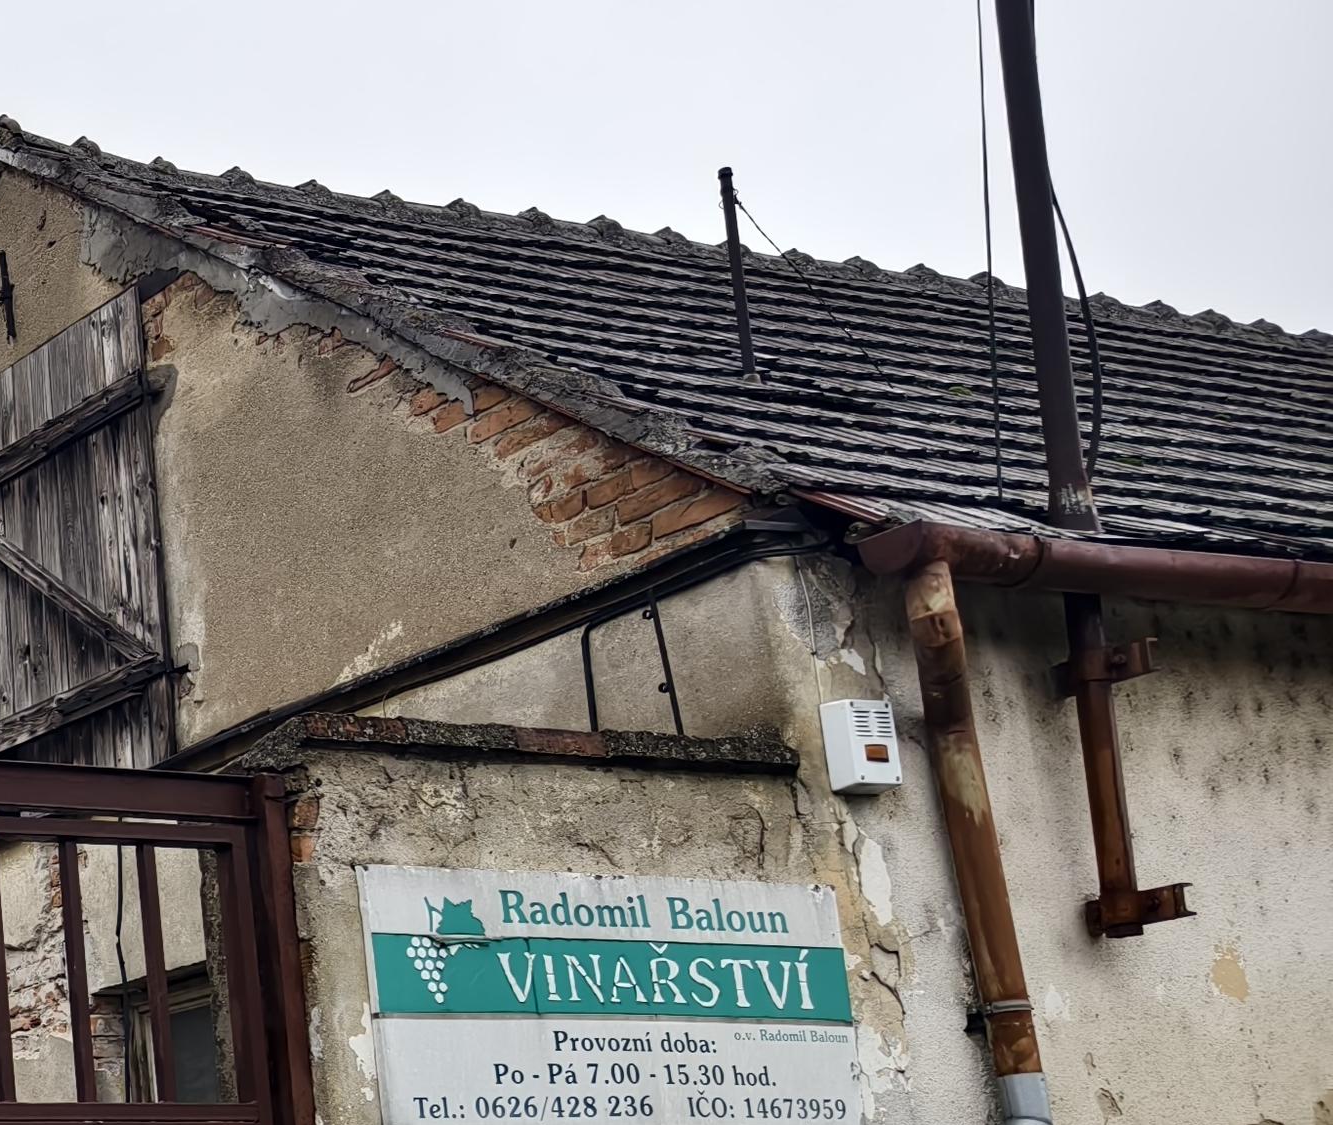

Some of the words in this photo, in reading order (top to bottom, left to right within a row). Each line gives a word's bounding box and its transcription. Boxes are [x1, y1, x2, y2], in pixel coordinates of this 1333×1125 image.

[499, 889, 651, 929] Radomil
[666, 896, 789, 934] Baloun
[496, 942, 815, 1010] VINAŘSTVÍ
[552, 1030, 653, 1053] Provozní
[660, 1032, 717, 1054] doba:
[759, 1029, 807, 1043] Radomil
[810, 1030, 849, 1044] Baloun
[493, 1063, 525, 1085] Po
[547, 1063, 578, 1085] Pá
[586, 1063, 640, 1085] 7.00
[663, 1064, 725, 1086] 15.30
[732, 1065, 777, 1087] hod.
[413, 1097, 465, 1119] Tel.:
[475, 1096, 598, 1121] 0626/428
[607, 1095, 654, 1118] 236
[687, 1090, 735, 1119] IČO:
[744, 1098, 847, 1120] 14673959
